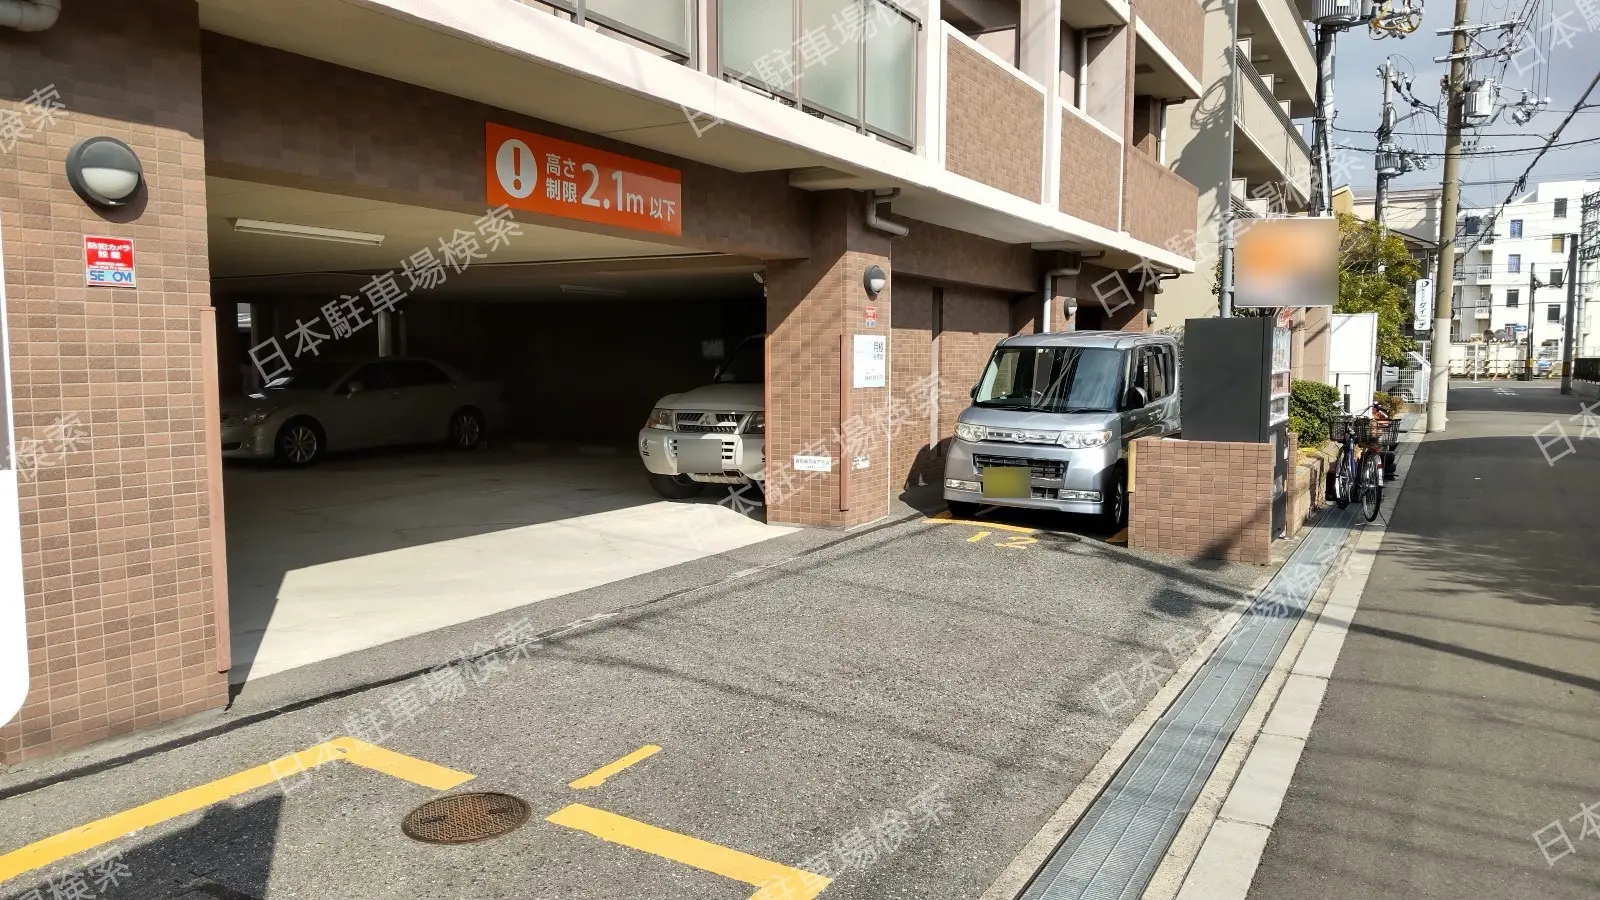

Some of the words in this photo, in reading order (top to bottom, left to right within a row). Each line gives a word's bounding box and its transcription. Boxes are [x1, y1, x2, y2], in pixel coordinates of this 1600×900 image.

[545, 153, 576, 179] 高さ
[545, 178, 578, 205] 制限
[581, 162, 644, 215] 2.1m
[650, 196, 676, 222] 以下
[89, 270, 133, 282] SEOM
